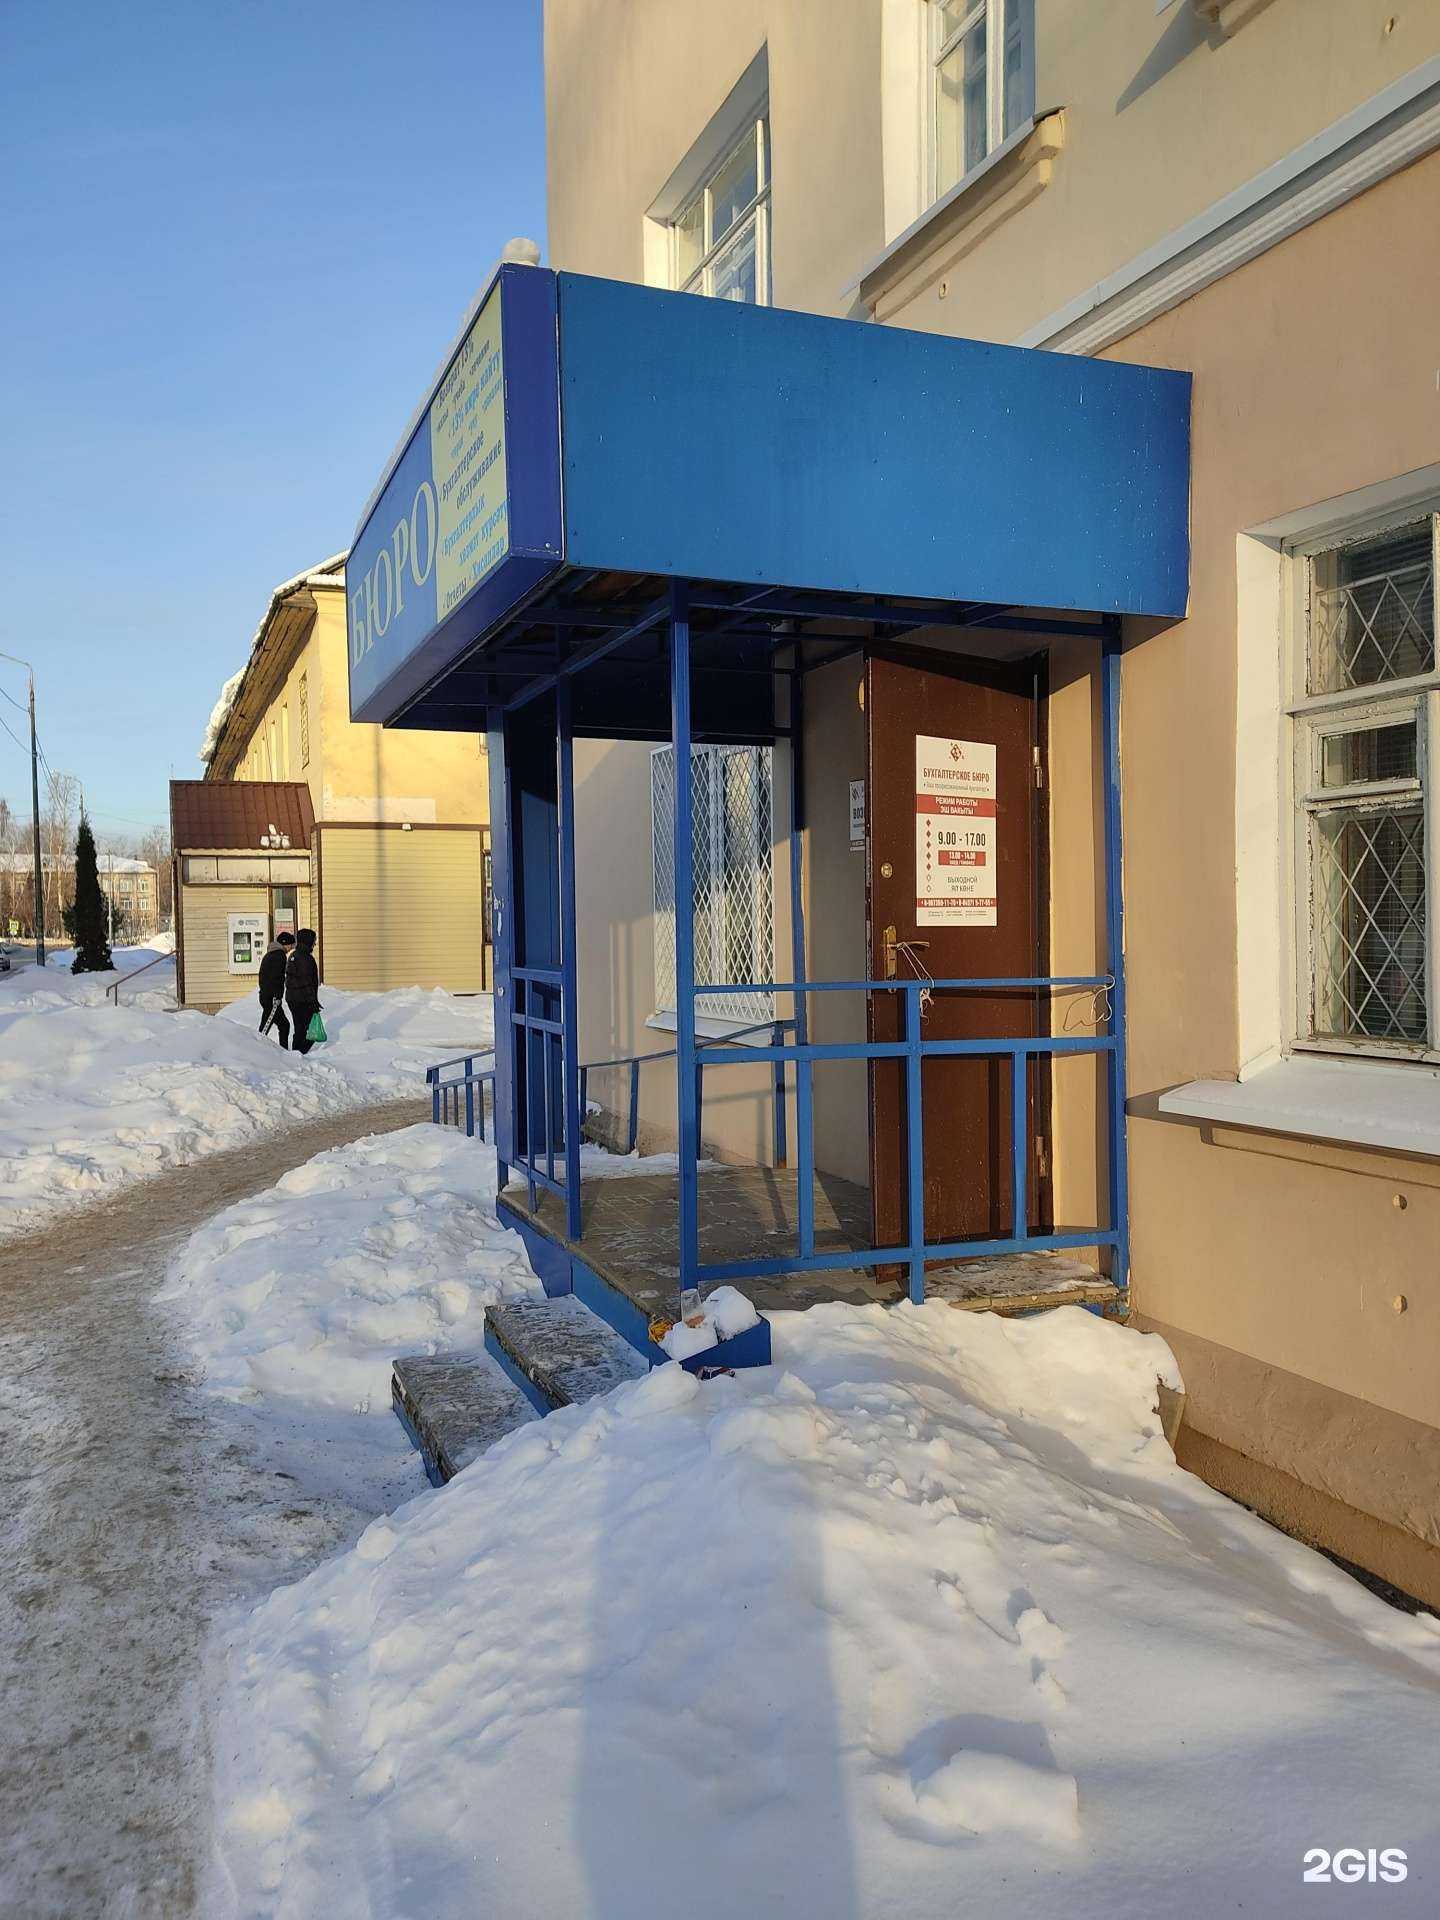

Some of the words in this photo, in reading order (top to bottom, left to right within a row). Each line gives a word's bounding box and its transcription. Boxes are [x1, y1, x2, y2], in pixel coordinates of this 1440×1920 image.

[441, 429, 485, 503] Бухгалтерское
[456, 438, 502, 511] обслуживание
[350, 480, 437, 670] БЮРО
[923, 767, 971, 782] БУХГАЛТЕРСКОЕ
[972, 771, 990, 783] БЮРО
[935, 796, 956, 805] РЕЖИМ
[955, 798, 978, 807] РАБОТЫ
[938, 831, 957, 845] 9.00
[965, 832, 986, 847] 17.00
[948, 875, 978, 884] ВЫХОДНОЙ
